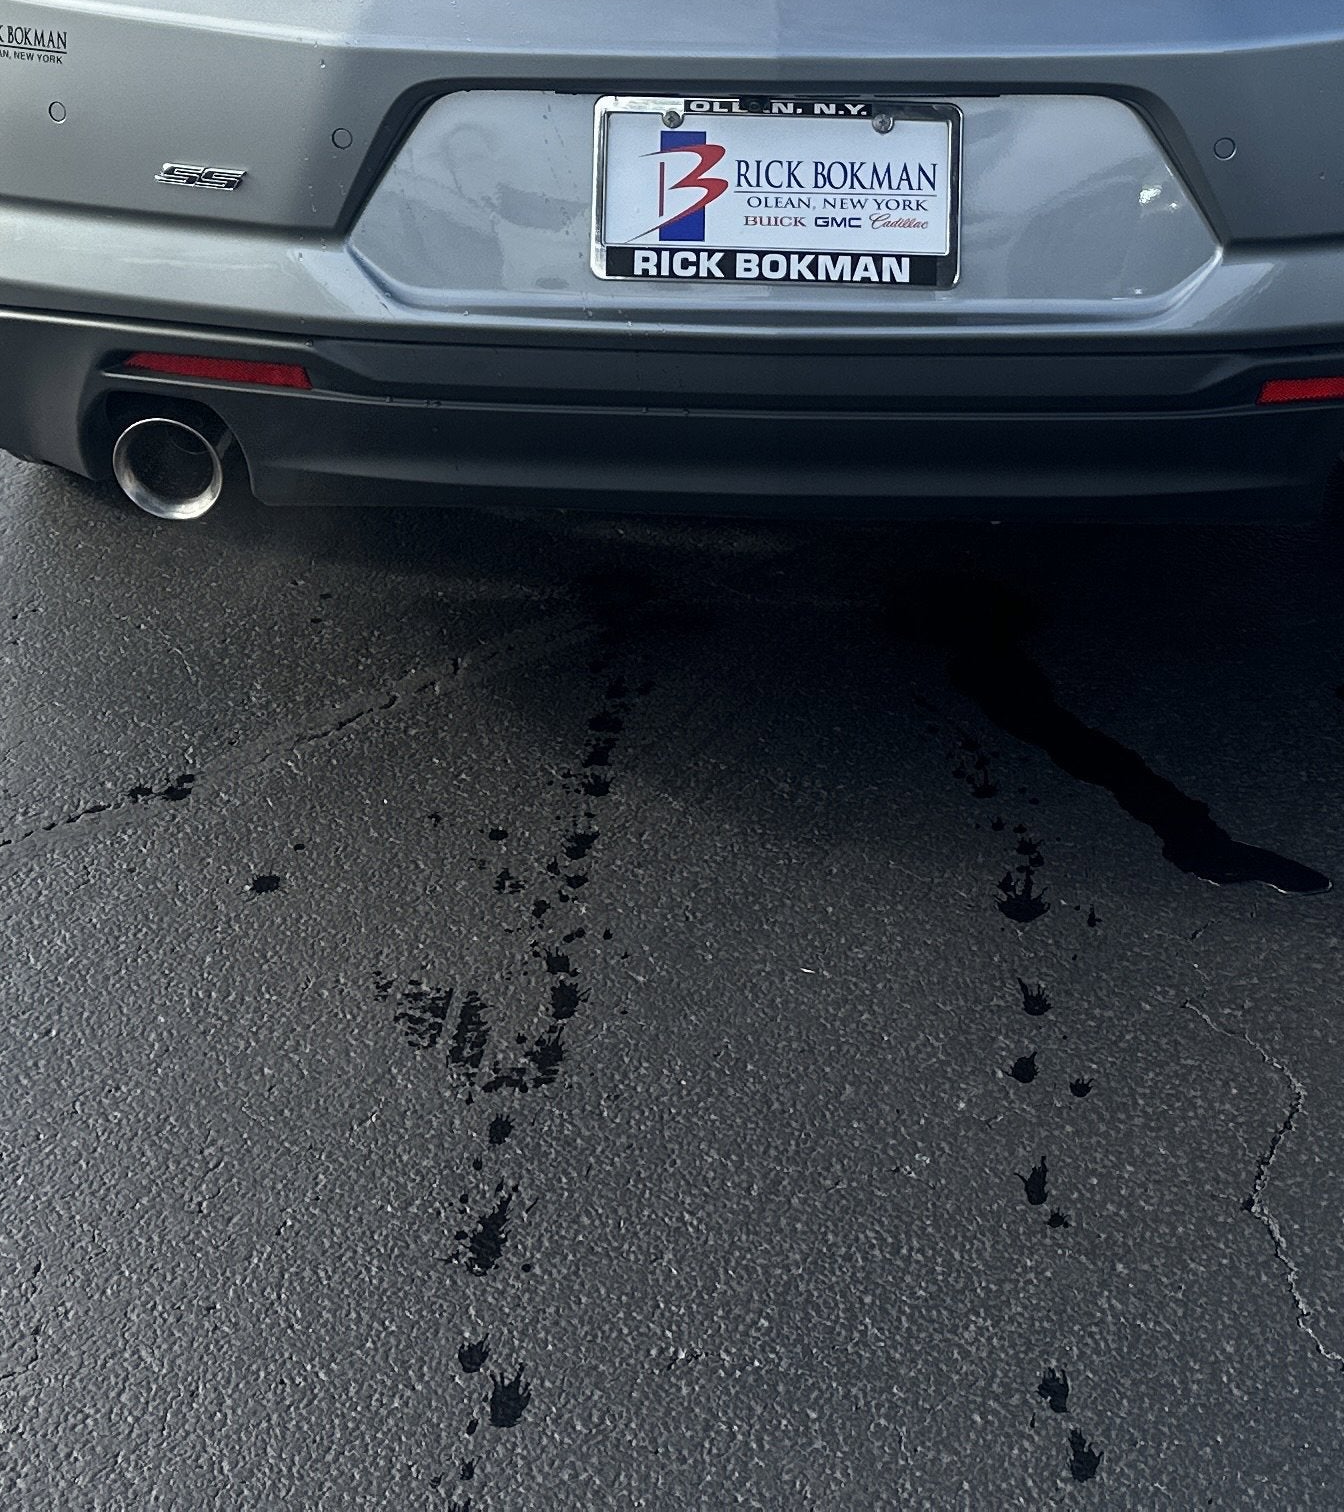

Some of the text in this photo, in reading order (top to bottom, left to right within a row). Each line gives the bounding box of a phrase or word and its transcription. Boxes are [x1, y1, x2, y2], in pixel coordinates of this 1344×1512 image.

[7, 25, 67, 50] BOKMAN
[13, 50, 35, 62] NEW
[36, 53, 63, 64] YORK
[813, 103, 868, 116] N.Y.
[154, 162, 248, 191] SS
[735, 159, 938, 191] RICK BOKMAN
[746, 196, 929, 212] OLEAN, NEW YORK
[743, 213, 929, 230] BUICK GMC Cadillac
[633, 250, 910, 283] RICK BOKMAN
